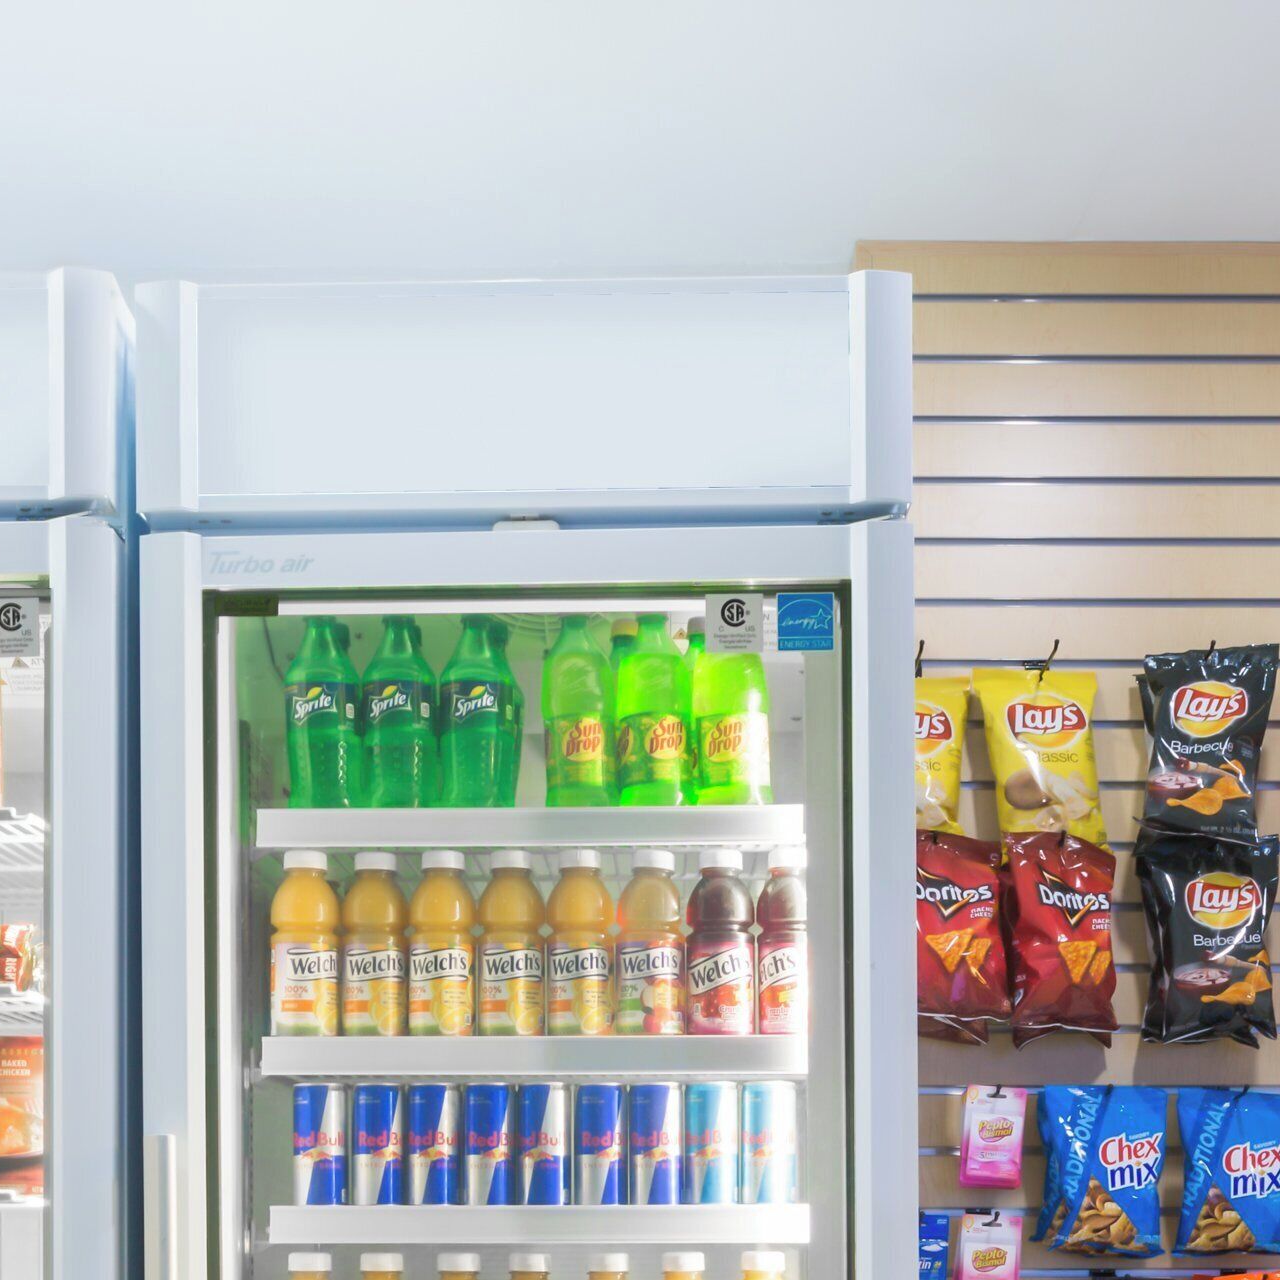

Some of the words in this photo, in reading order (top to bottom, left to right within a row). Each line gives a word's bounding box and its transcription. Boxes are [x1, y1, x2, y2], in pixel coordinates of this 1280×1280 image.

[208, 551, 274, 574] Turbo
[281, 555, 314, 573] air
[294, 693, 332, 719] Sprite
[370, 693, 408, 718] Sprite
[454, 693, 495, 718] Sprite
[570, 718, 602, 738] Sun
[653, 715, 683, 735] Sun
[713, 720, 743, 739] Sun
[566, 734, 600, 757] Drop
[649, 732, 682, 755] Drop
[708, 735, 742, 757] Drop
[1170, 740, 1234, 756] Barbecue
[915, 882, 993, 904] Doritos
[1039, 883, 1110, 911] Doritos
[348, 952, 404, 976] Welch's
[412, 952, 467, 975] Welch's
[485, 953, 541, 976] Welch's
[552, 952, 608, 976] Welch's
[623, 951, 678, 975] Welch's
[358, 1132, 388, 1147] Red
[468, 1132, 497, 1147] Red
[582, 1132, 612, 1147] Red
[1100, 1135, 1160, 1166] Chex
[1110, 1157, 1159, 1188] mix
